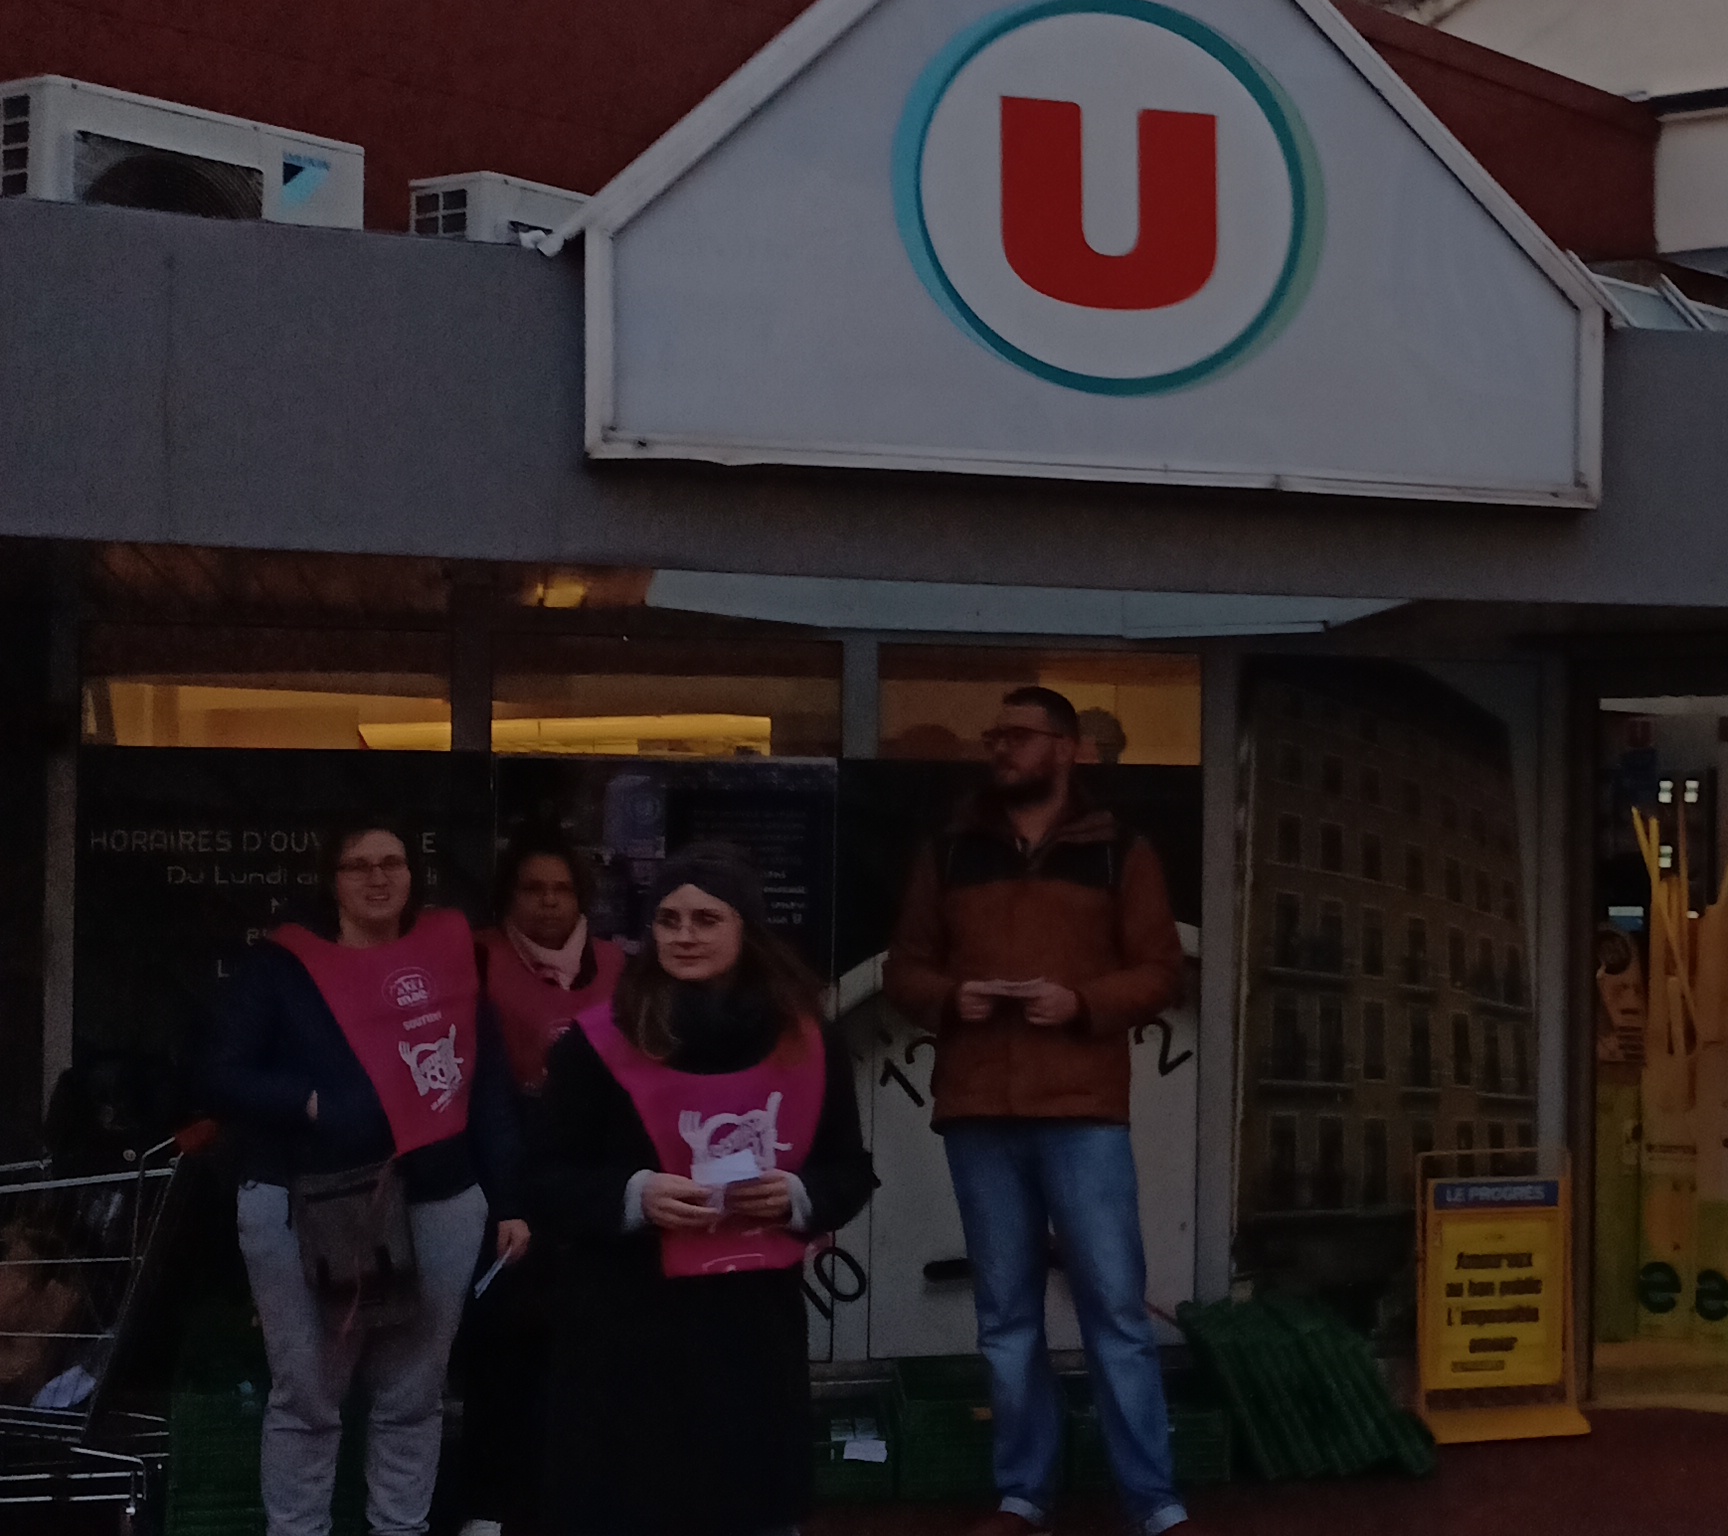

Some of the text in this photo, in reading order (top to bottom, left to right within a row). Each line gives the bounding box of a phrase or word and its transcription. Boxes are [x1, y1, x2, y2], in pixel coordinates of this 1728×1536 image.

[1000, 96, 1216, 310] U
[90, 830, 232, 854] HORAIRES
[167, 866, 201, 886] Du
[213, 865, 289, 886] Lundi
[1445, 1187, 1465, 1202] LE
